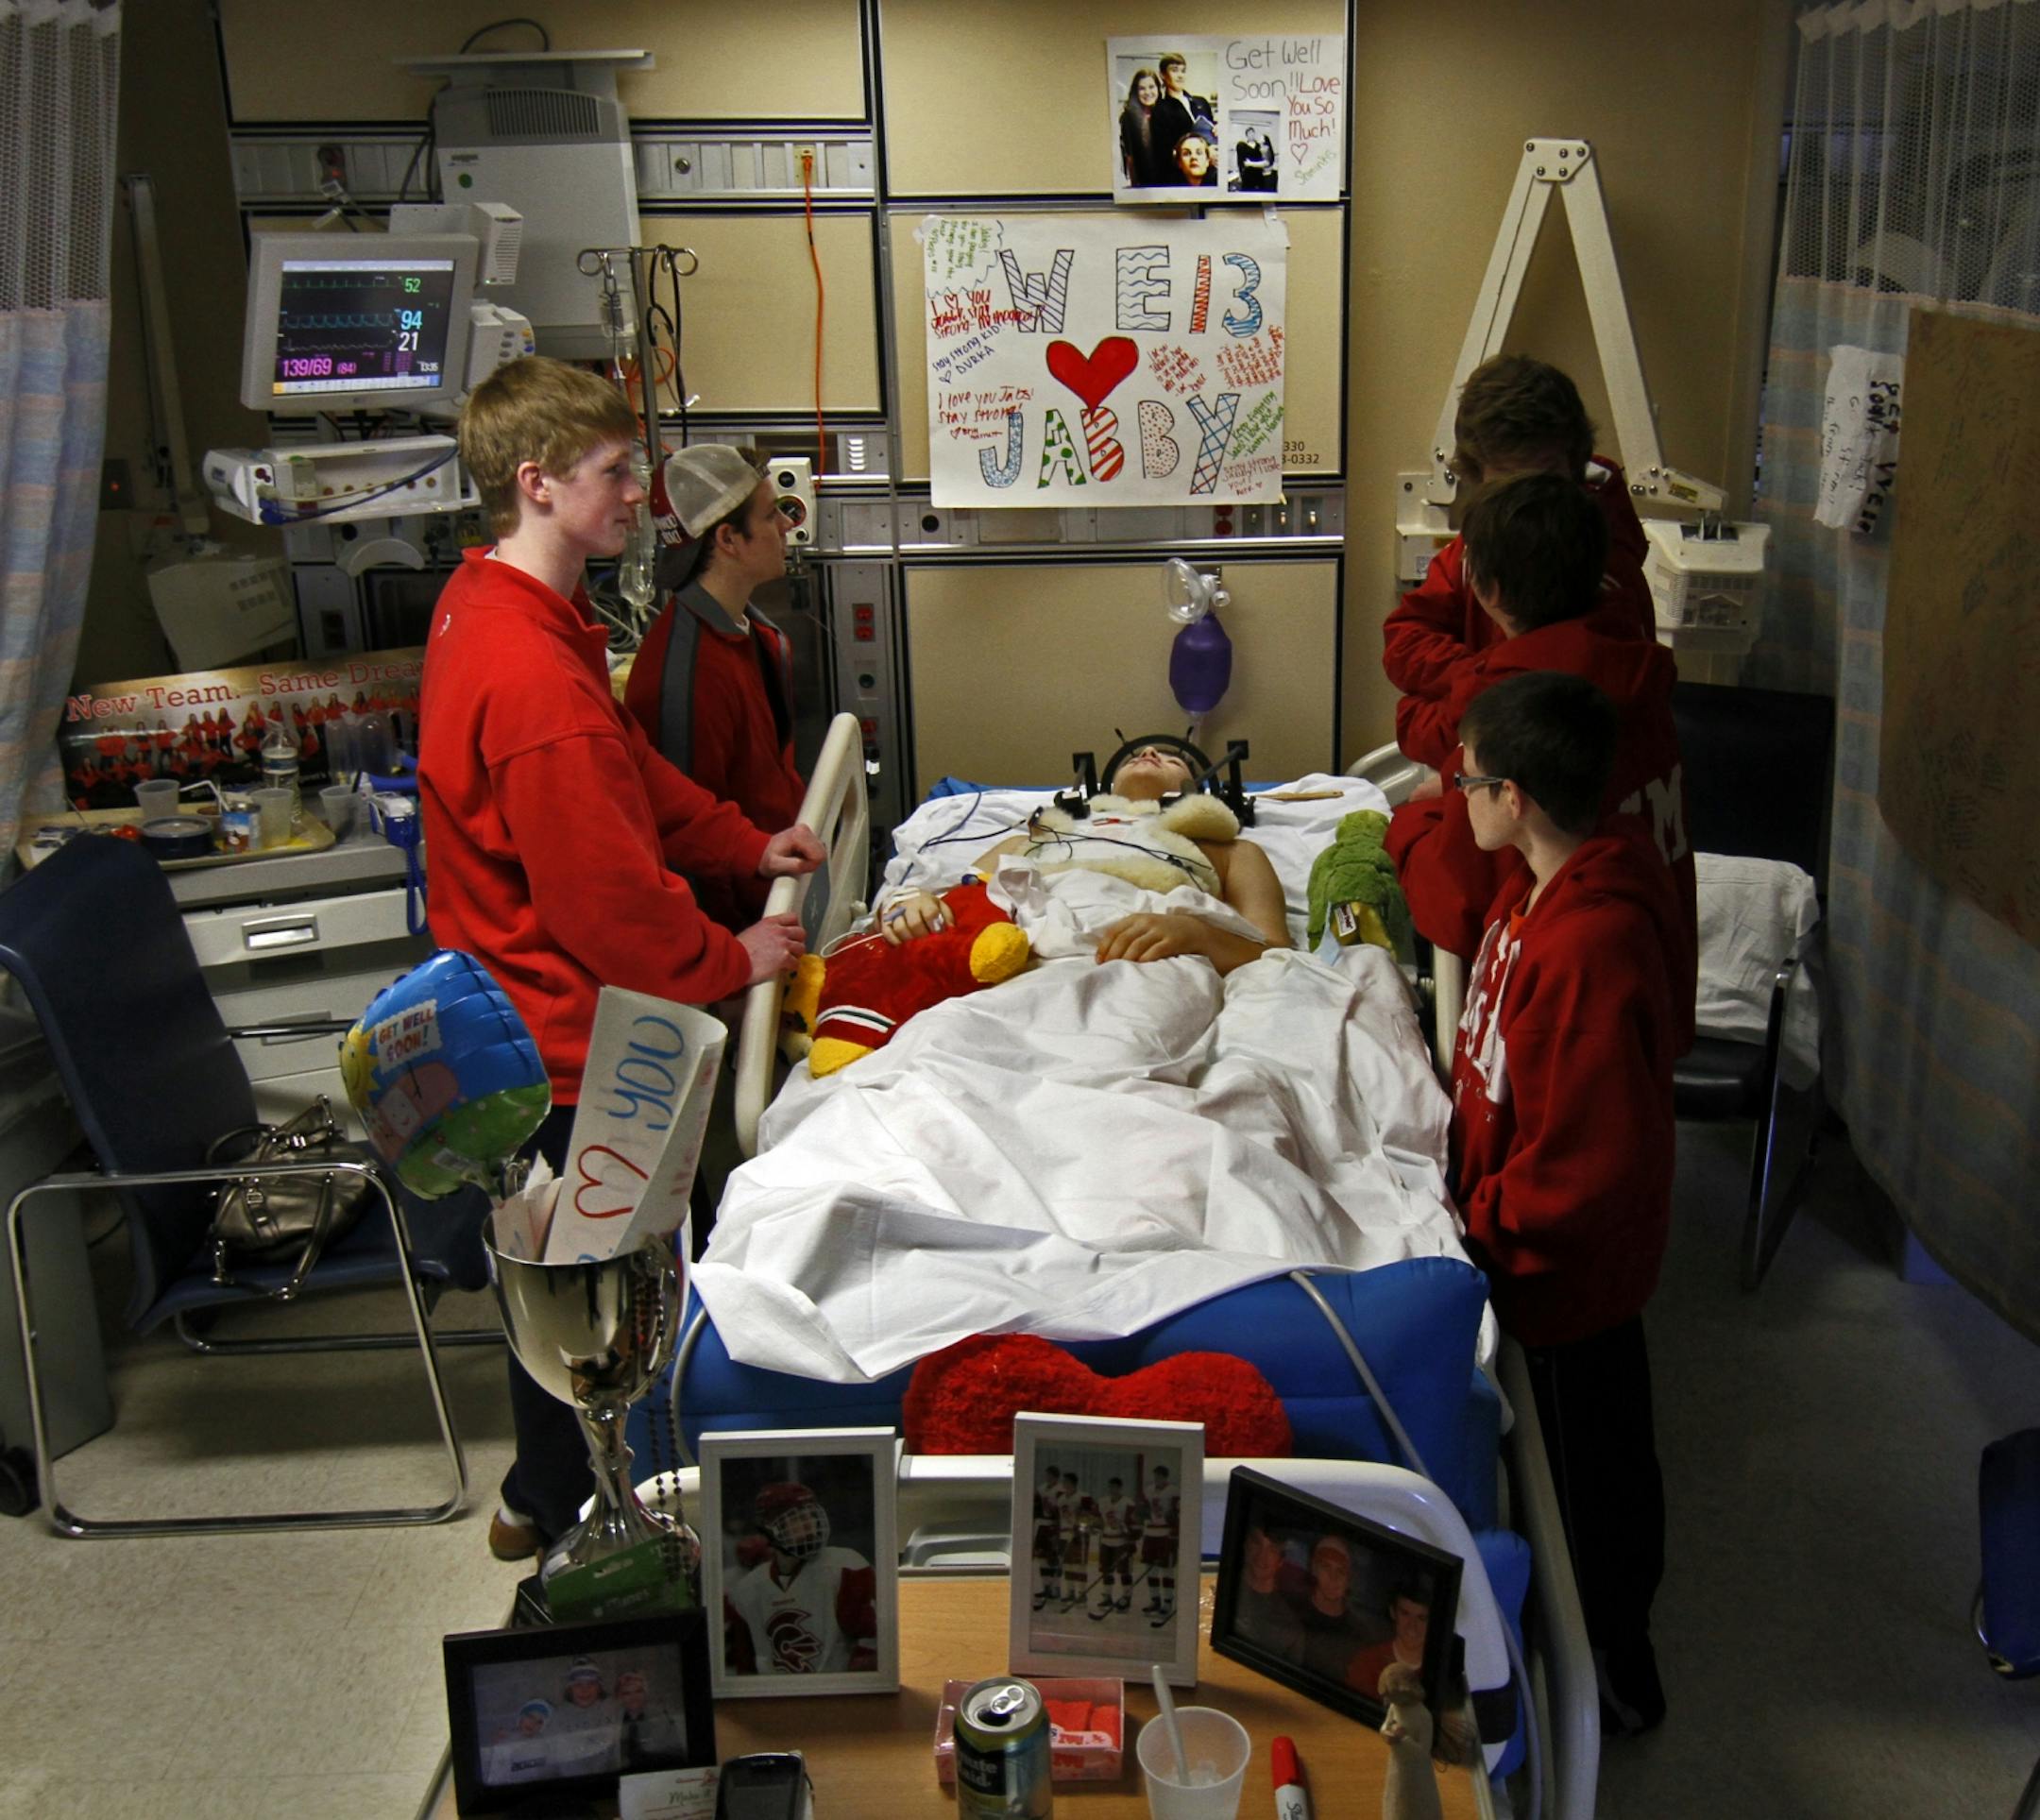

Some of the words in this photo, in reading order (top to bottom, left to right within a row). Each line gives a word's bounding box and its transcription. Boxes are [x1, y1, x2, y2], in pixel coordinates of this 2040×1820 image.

[1226, 40, 1275, 70] Get
[1282, 39, 1321, 64] Well
[1300, 73, 1341, 94] Love
[1287, 95, 1311, 116] You
[1315, 96, 1334, 115] So
[403, 278, 421, 293] 52
[400, 310, 423, 330] 94
[398, 332, 418, 351] 21
[283, 358, 332, 377] 139/69
[978, 393, 1241, 495] JABBY
[66, 693, 138, 723] New
[145, 684, 242, 711] Team.
[258, 670, 340, 696] Same
[379, 1021, 400, 1046] GET
[402, 1009, 434, 1031] WELL
